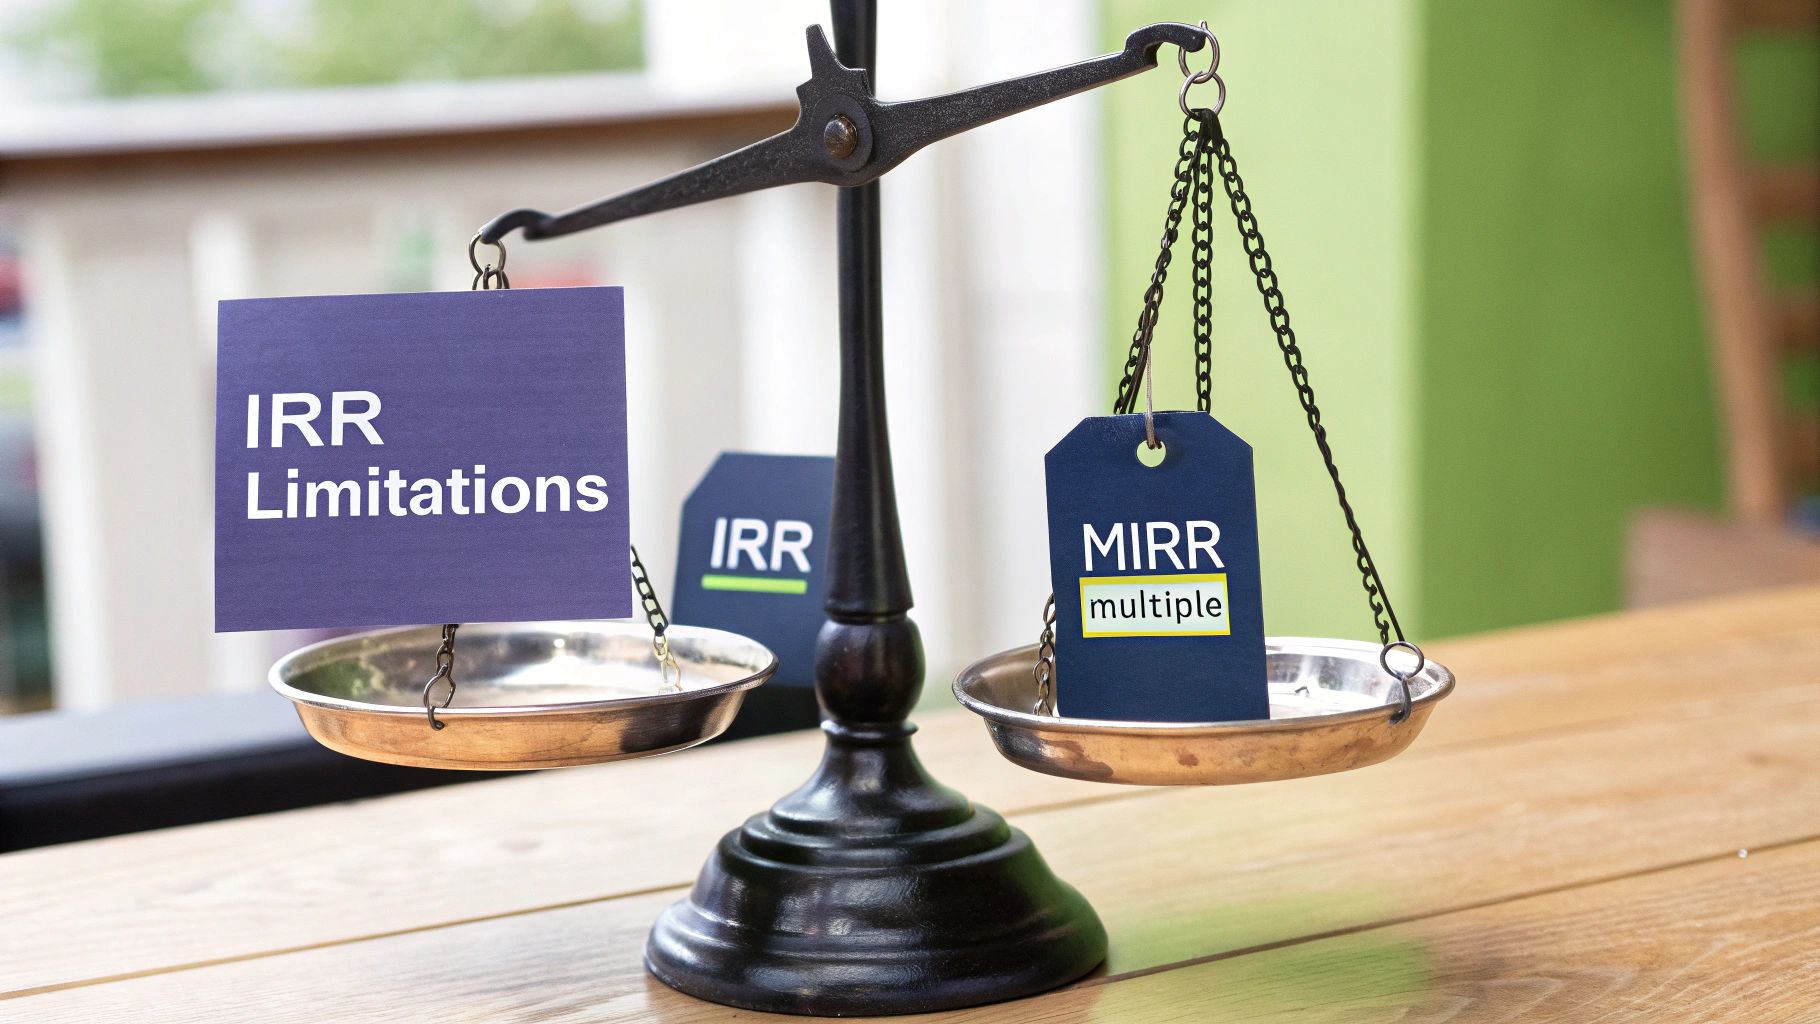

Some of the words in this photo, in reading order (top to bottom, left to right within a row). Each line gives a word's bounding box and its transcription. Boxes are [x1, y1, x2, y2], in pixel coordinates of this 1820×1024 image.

[246, 390, 385, 449] IRR
[247, 464, 609, 520] Limitations
[710, 517, 813, 573] IRR
[1083, 520, 1225, 572] MIRR
[1090, 589, 1223, 625] multiple
